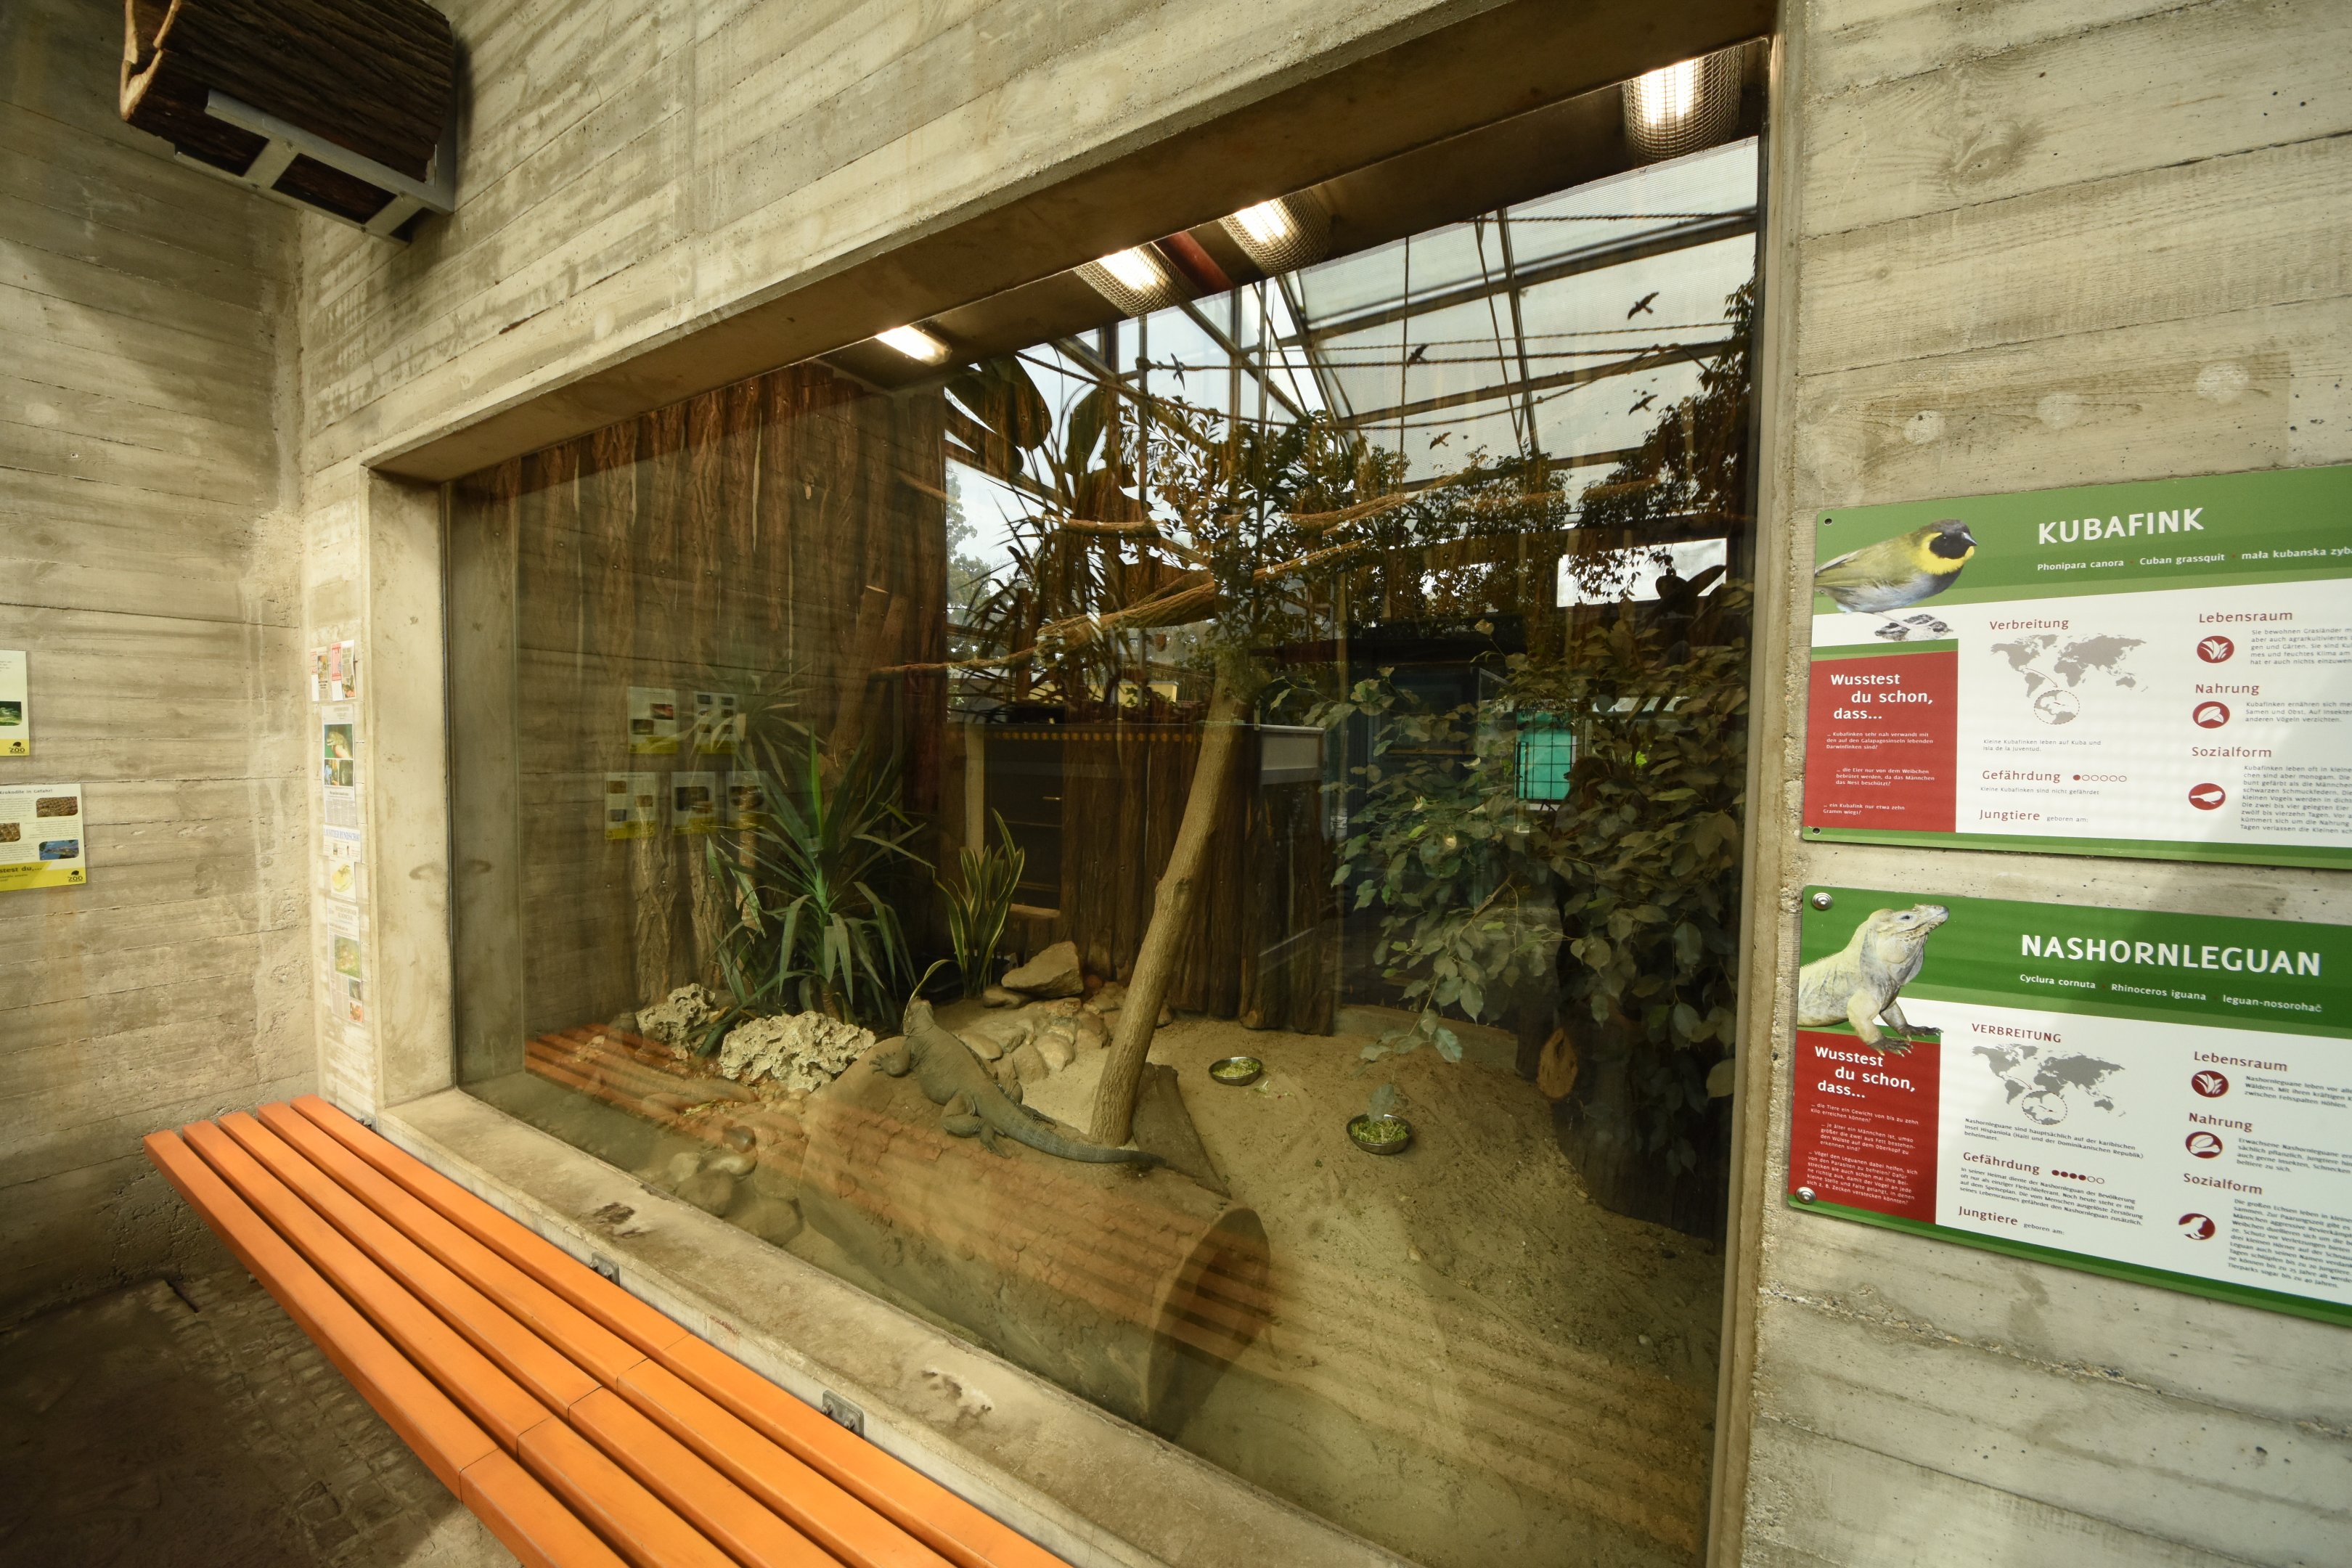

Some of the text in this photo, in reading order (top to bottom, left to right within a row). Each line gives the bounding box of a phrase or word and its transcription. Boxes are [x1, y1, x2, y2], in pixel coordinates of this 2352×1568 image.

[2039, 509, 2205, 544] KUBAFINK
[2037, 561, 2086, 573] Phonipara
[2139, 556, 2172, 565] Cuban
[2176, 553, 2225, 565] grassquit
[2273, 548, 2327, 558] kubanska
[1990, 618, 2070, 633] Verbreitung
[2200, 611, 2293, 623] Lebensraum
[1831, 674, 1900, 685] Wusstest
[1851, 690, 1933, 705] du schon,
[2195, 683, 2260, 697] Nahrung
[1834, 708, 1882, 719] dass...
[2192, 746, 2272, 758] Sozialform
[1983, 770, 2061, 783] Gefährdung
[1980, 809, 2041, 822] Jungtiere
[2022, 934, 2320, 976] NASHORNLEGUAN
[2020, 973, 2322, 1014] Cyclura cornuta Rhinoceros iguana leguan-nosorohač
[1972, 1024, 2062, 1042] VERBREITUNG
[1816, 1046, 1883, 1067] Wusstest
[2194, 1052, 2288, 1071] Lebensraum
[1834, 1066, 1916, 1092] du schon,
[1818, 1080, 1866, 1098] dass...
[2189, 1112, 2253, 1132] Nahrung
[1964, 1151, 2040, 1175] Gefährdung
[2183, 1173, 2263, 1195] Sozialform
[1959, 1205, 2018, 1228] Jungtiere
